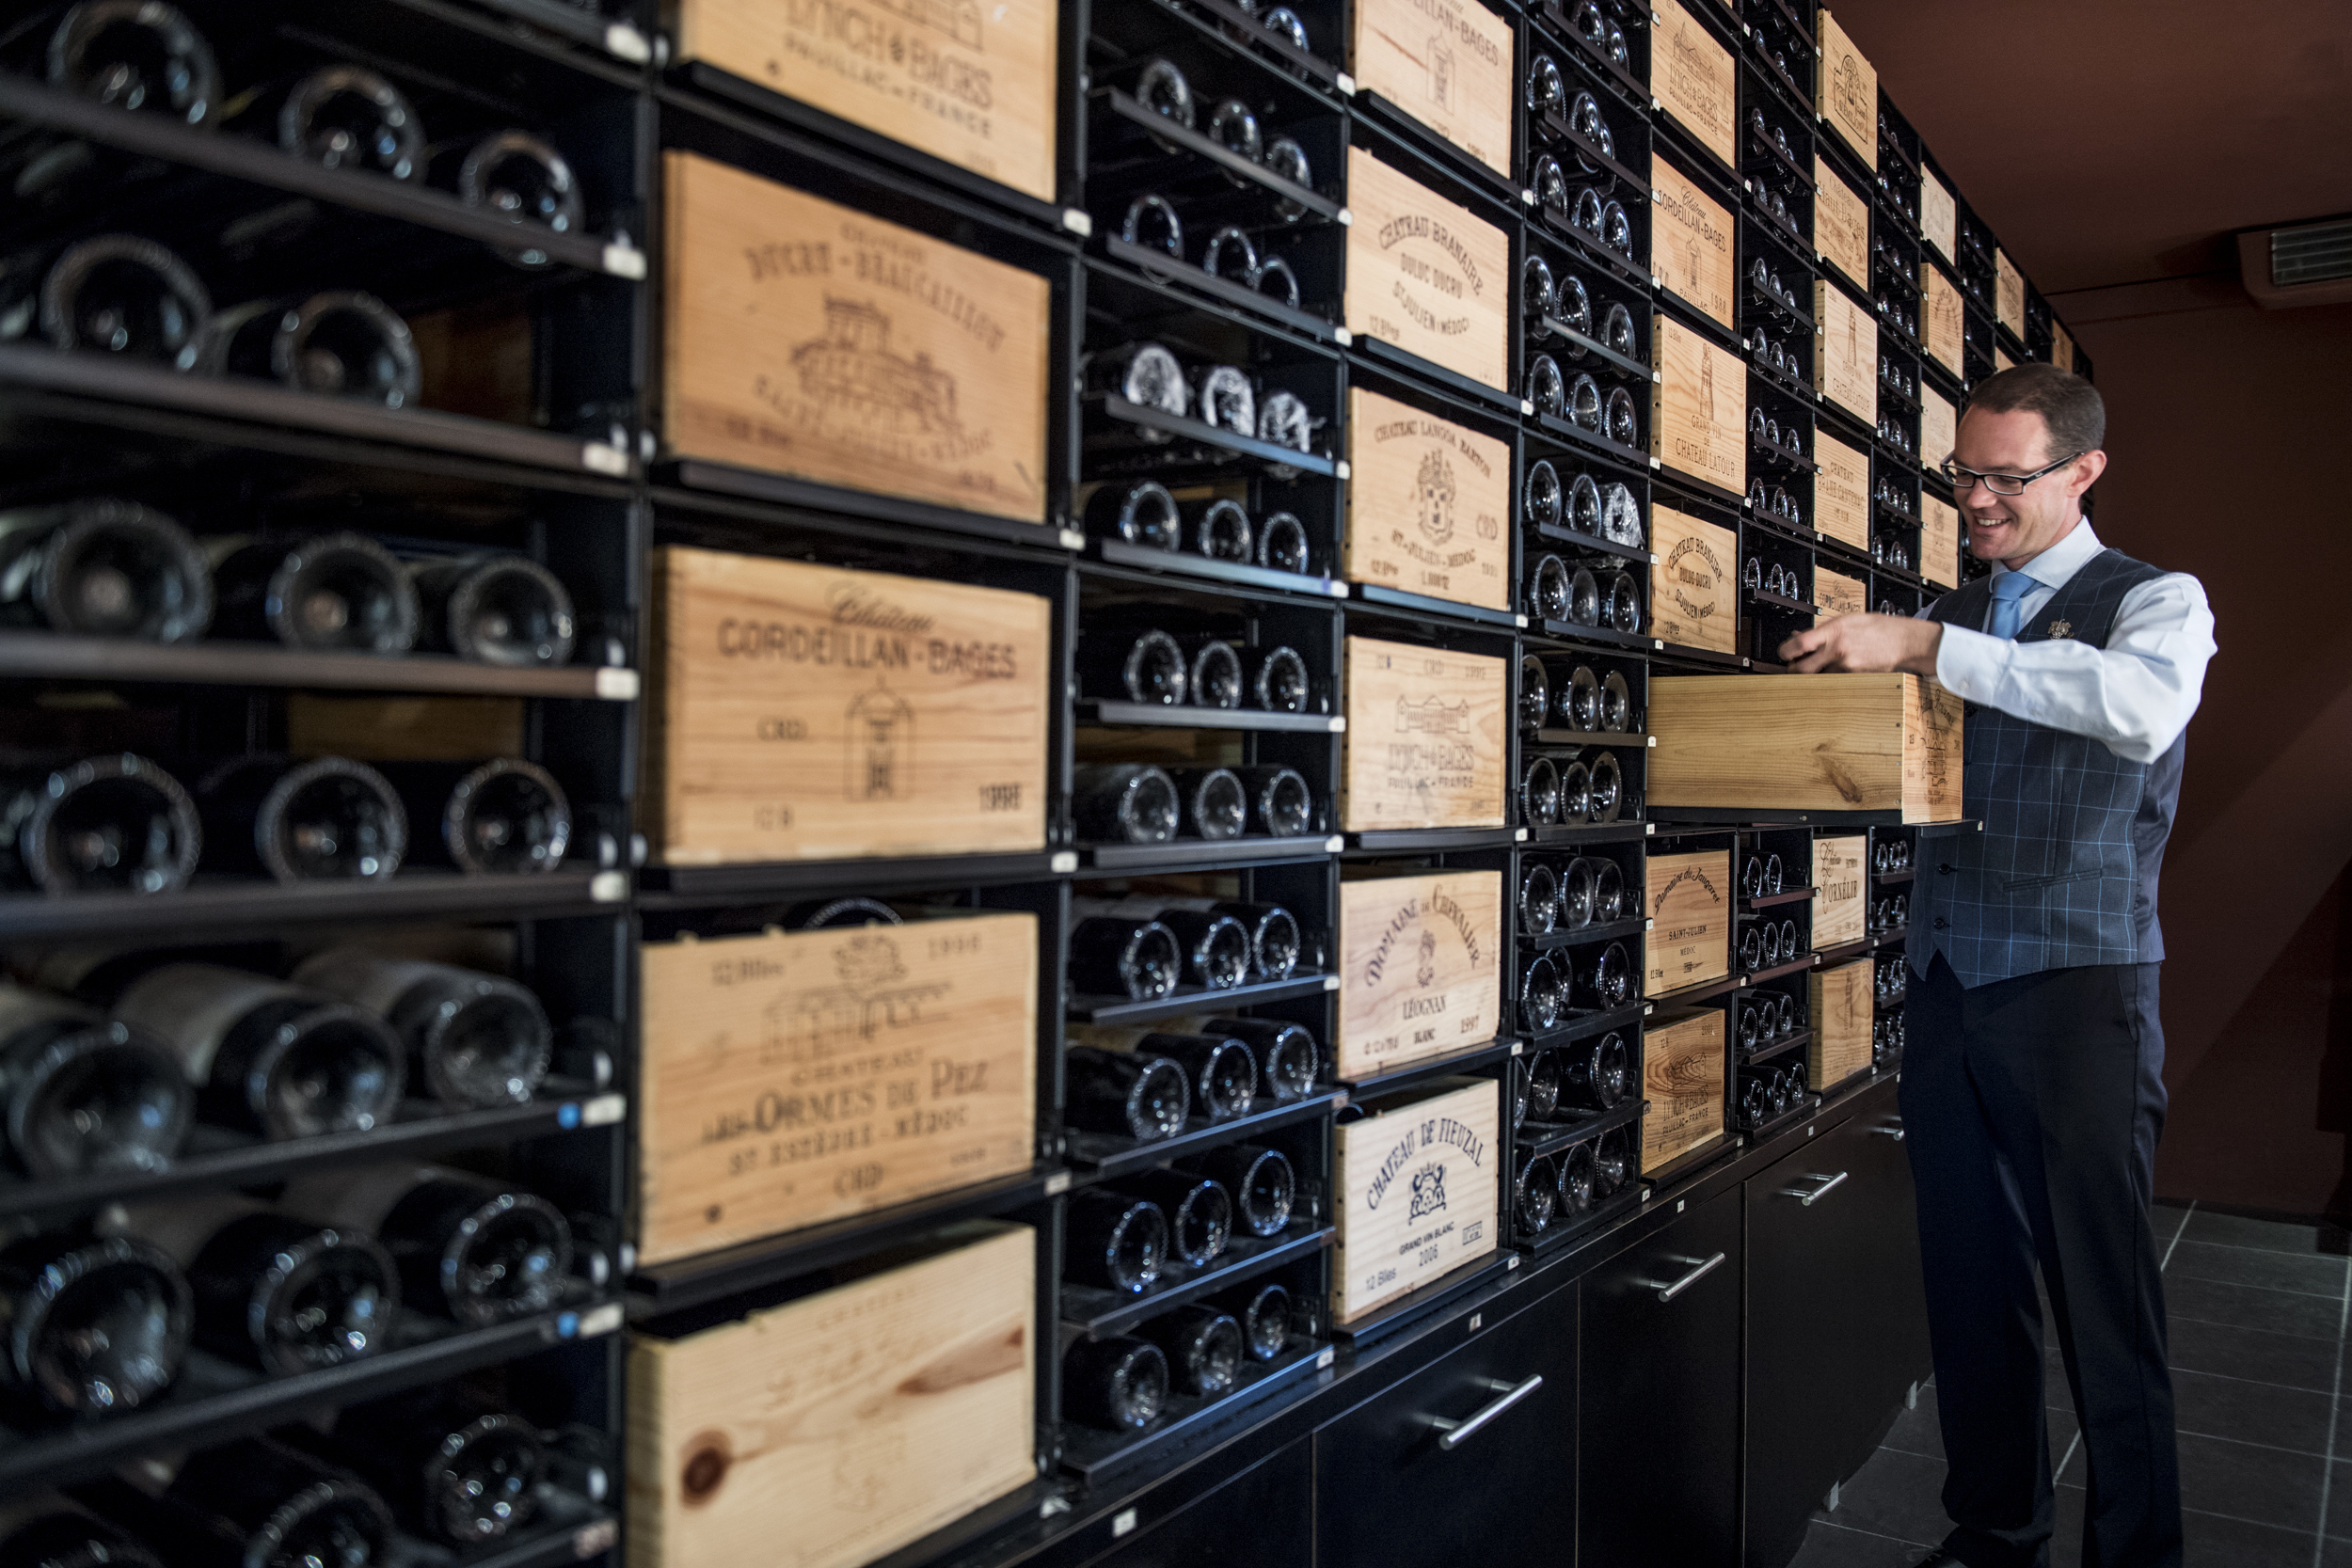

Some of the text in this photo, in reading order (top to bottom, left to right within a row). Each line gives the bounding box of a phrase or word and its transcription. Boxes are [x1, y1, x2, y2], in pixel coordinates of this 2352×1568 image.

[1669, 62, 1718, 123] LYNCH BAGES
[1681, 185, 1707, 220] Château
[1378, 214, 1484, 296] CHATEAU BRANAIRE
[1401, 252, 1463, 299] DULUC DUCRU
[1679, 288, 1708, 312] PAUILLAC
[1692, 414, 1722, 439] GRAND VIN
[1704, 436, 1710, 447] DE
[1375, 420, 1492, 479] CHATEAU LANGOA BARTON
[1676, 437, 1736, 479] CHATEAU LATOUR
[1668, 537, 1723, 584] CHATEAU BRANAIRE
[1679, 566, 1712, 590] DULUC DUCRU
[716, 616, 1019, 679] CORDEILLAN-BAGES
[1438, 743, 1474, 771] BAGES
[1654, 864, 1721, 916] Domaine du Jaugaret
[1366, 898, 1418, 988] DOMAINE
[1433, 883, 1480, 969] CHEVALIER
[1669, 925, 1708, 941] SAINT-JULIEN
[1680, 945, 1696, 957] MÉDOC
[1414, 1028, 1436, 1044] BLANC
[754, 1080, 876, 1132] ORMES
[930, 1057, 990, 1099] PEZ
[1663, 1085, 1709, 1122] LYNCH BAGES
[1367, 1118, 1484, 1210] CHATEAU DE FIEUZAL
[1399, 1238, 1422, 1256] GRAND
[1423, 1230, 1434, 1245] VIN
[1434, 1221, 1454, 1241] BLANC
